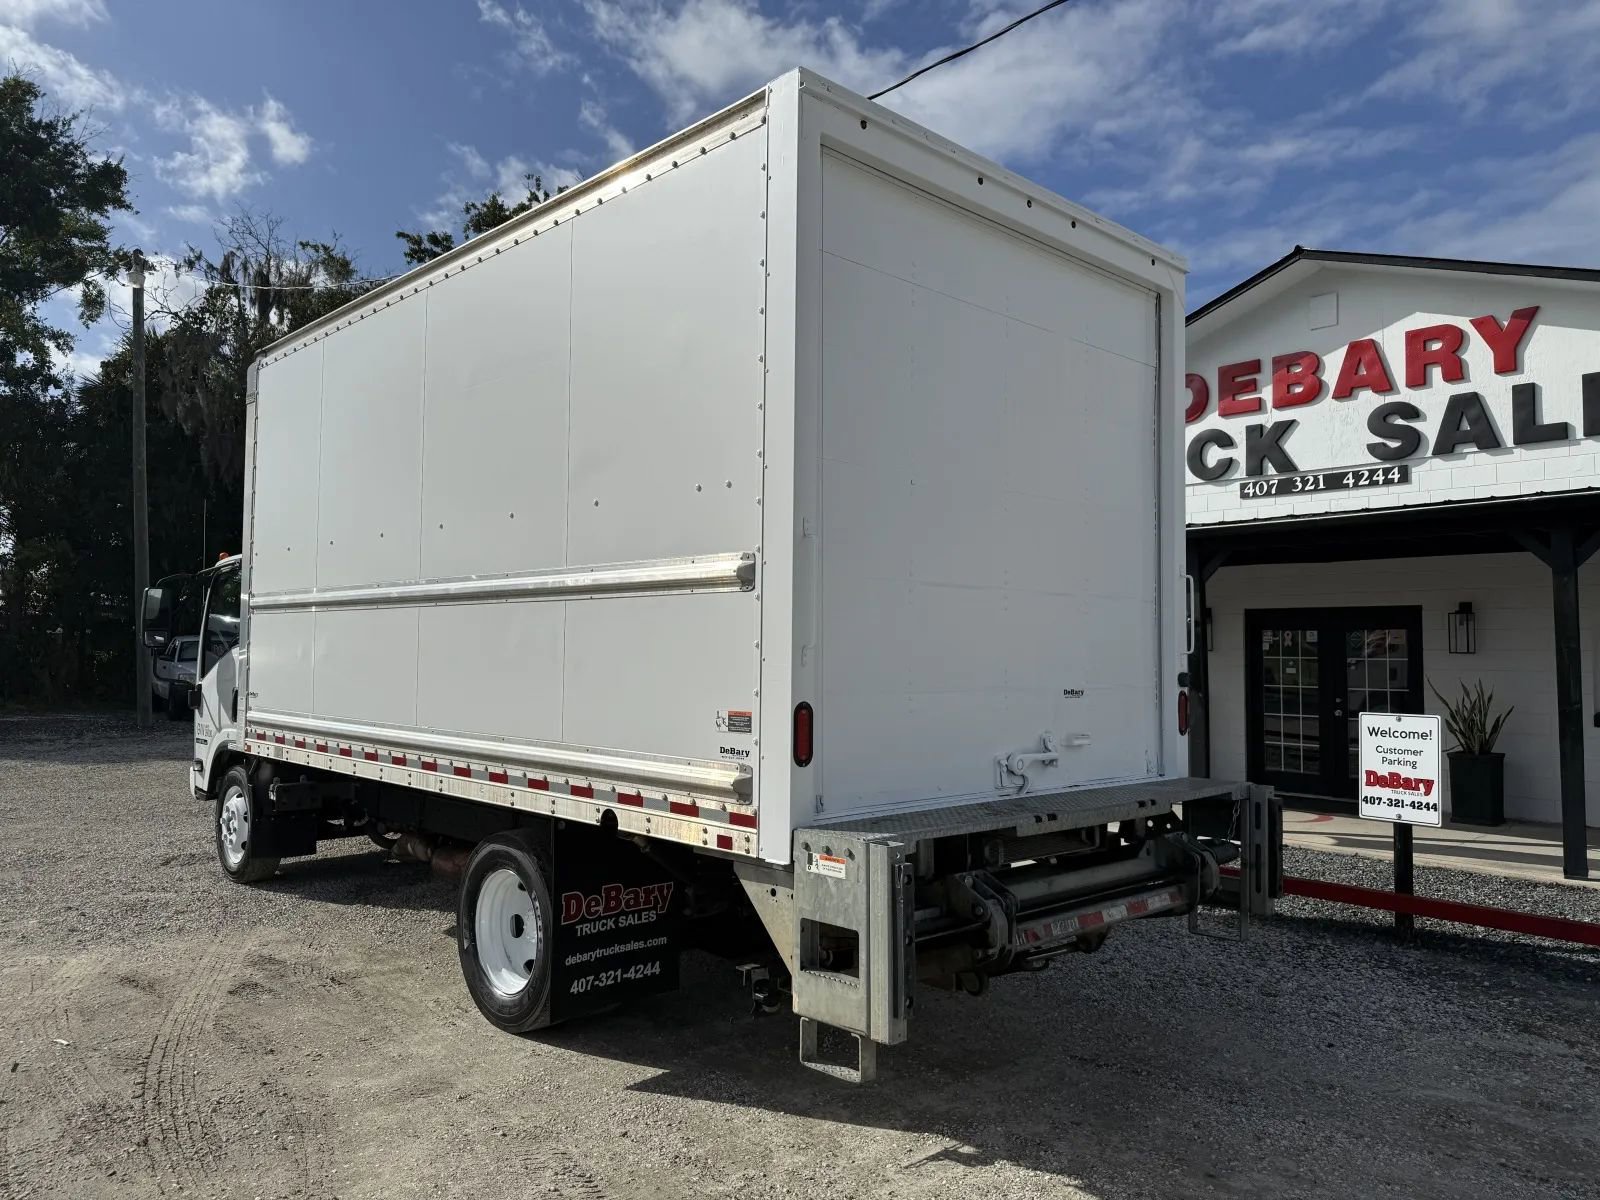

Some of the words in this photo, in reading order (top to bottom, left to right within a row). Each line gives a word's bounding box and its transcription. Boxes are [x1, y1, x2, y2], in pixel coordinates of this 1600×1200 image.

[1243, 480, 1279, 498] 407
[1292, 474, 1327, 493] 321
[1343, 466, 1401, 488] 4244
[1367, 726, 1433, 741] Welcome!
[719, 746, 750, 758] DeBary
[1375, 745, 1424, 757] Customer
[1381, 757, 1418, 769] Parking
[1365, 769, 1435, 797] DeBary
[1362, 795, 1438, 812] 407-321-4244
[561, 882, 674, 925] DeBary
[575, 917, 616, 937] TRUCK
[618, 910, 657, 928] SALES
[565, 936, 667, 966] debarytrucksales.com
[570, 960, 661, 995] 407-321-4244
